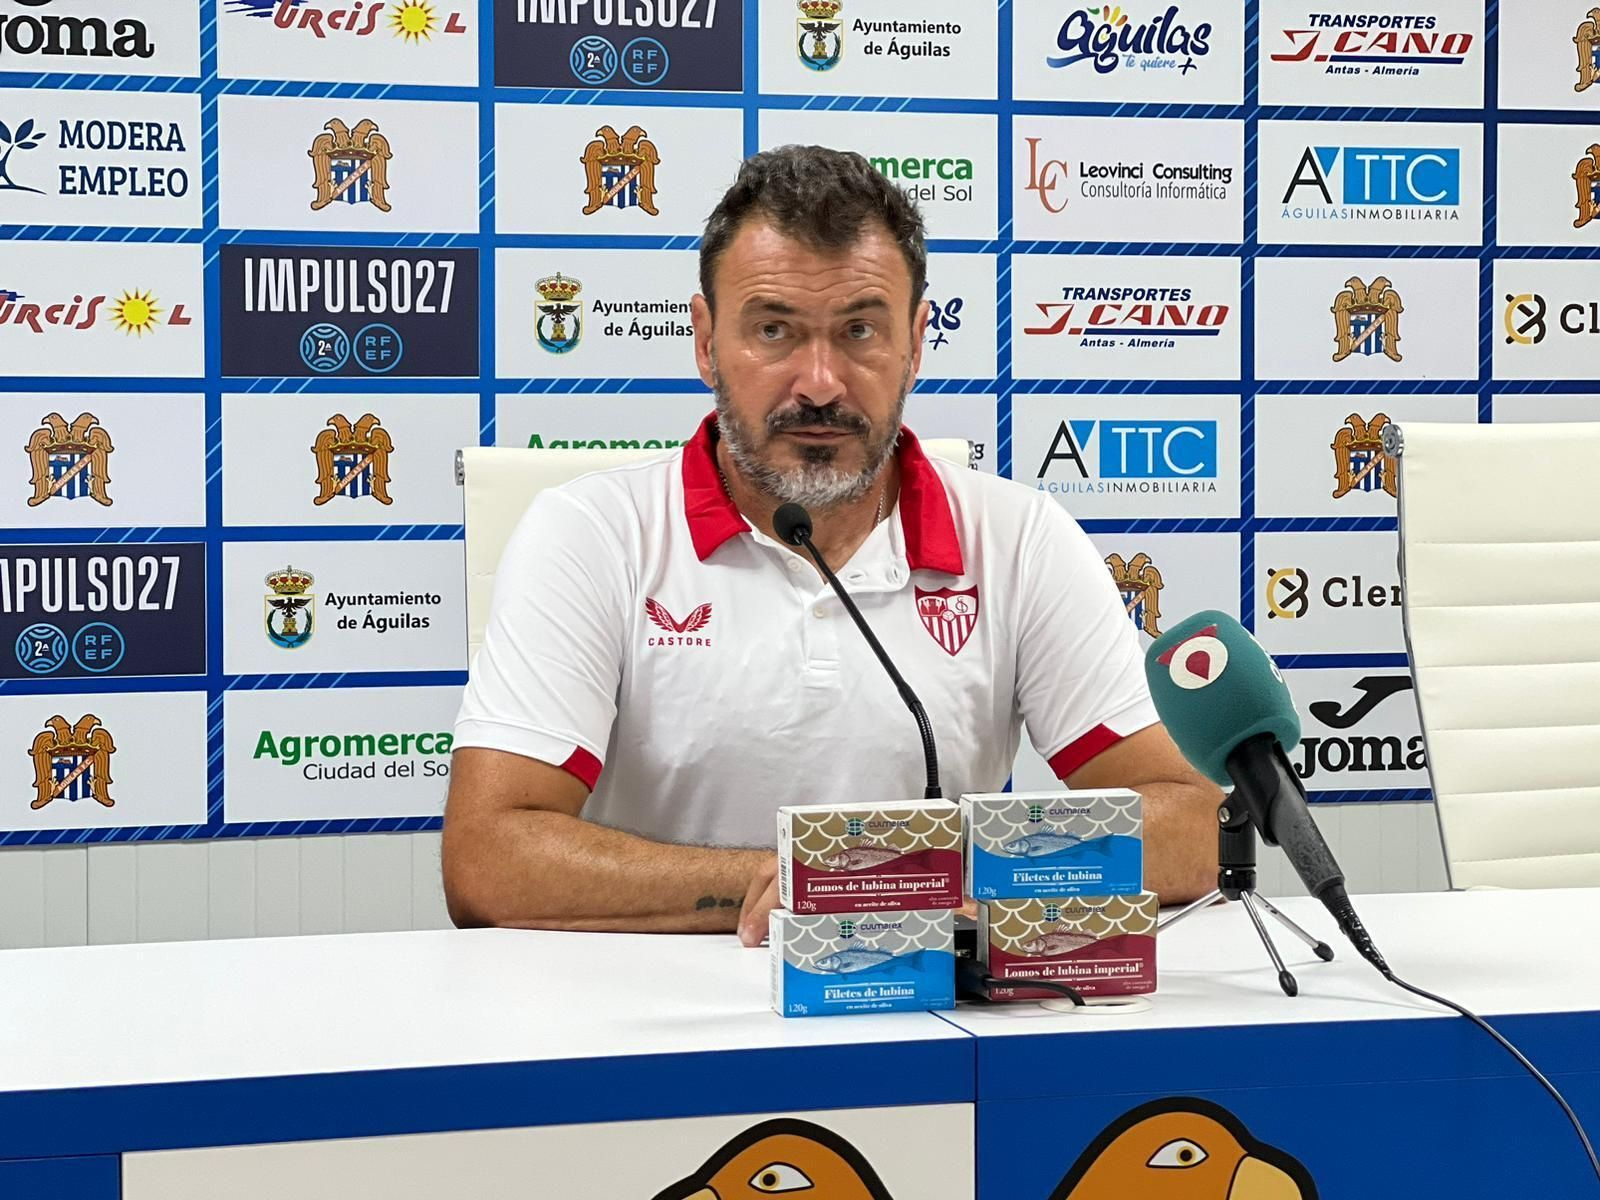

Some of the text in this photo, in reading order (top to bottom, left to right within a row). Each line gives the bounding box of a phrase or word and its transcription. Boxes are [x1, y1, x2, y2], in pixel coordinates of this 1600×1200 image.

[853, 18, 962, 37] Ayuntamiento
[1308, 13, 1437, 30] TRANSPORTES
[0, 14, 155, 58] oma
[864, 36, 951, 59] de Águilas
[1140, 57, 1176, 72] quiere
[1325, 65, 1361, 76] Antas
[58, 119, 186, 153] MODERA
[869, 157, 973, 180] merca
[1079, 161, 1233, 184] Leovinci Consulting
[58, 164, 190, 198] EMPLEO
[943, 184, 973, 201] Sol
[1080, 182, 1227, 200] Consultoría Informática
[244, 257, 457, 314] IMPULSO27
[1062, 287, 1192, 301] TRANSPORTES
[592, 299, 693, 317] Ayuntamien
[604, 317, 694, 341] de Águilas
[1079, 337, 1114, 347] Antas
[0, 556, 180, 613] PULSO27
[324, 591, 442, 608] Ayuntamiento
[336, 609, 431, 633] de Águilas
[648, 637, 712, 647] CASTORE
[253, 730, 454, 766] Agromerca
[303, 760, 449, 780] Ciudad del So
[1049, 806, 1091, 816] culmarex
[1013, 870, 1103, 883] Filetes de lubina
[807, 882, 844, 893] Lomos
[846, 881, 860, 891] de
[861, 879, 897, 891] lubina
[977, 887, 998, 898] 120g
[796, 901, 818, 912] 120g
[1005, 967, 1041, 978] Lomos
[1043, 965, 1056, 977] de
[1058, 964, 1092, 976] lubina
[824, 985, 915, 1000] Filetes de lubina
[788, 1003, 809, 1014] 120g
